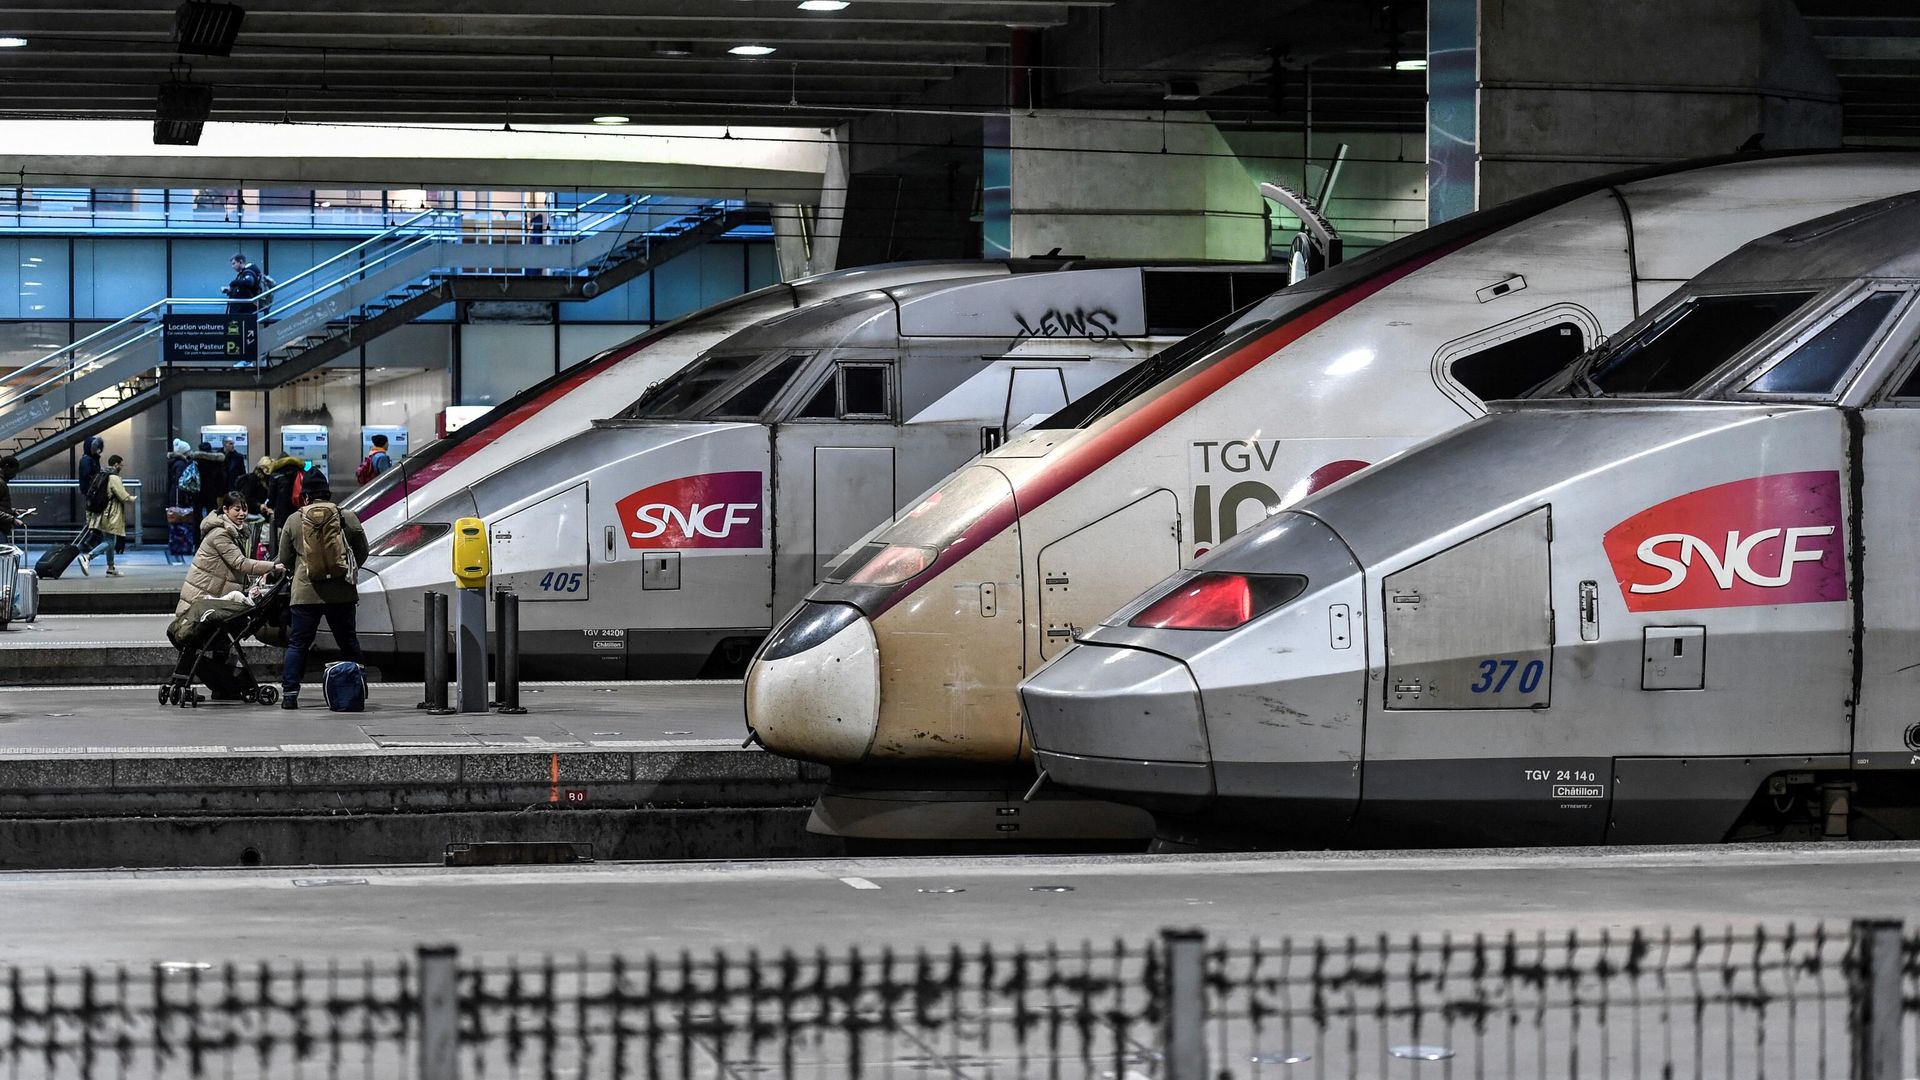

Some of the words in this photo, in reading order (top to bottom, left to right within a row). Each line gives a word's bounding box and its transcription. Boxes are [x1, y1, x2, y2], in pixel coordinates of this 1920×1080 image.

[168, 323, 197, 331] Location
[198, 323, 225, 331] voitures
[174, 342, 199, 351] Parking
[199, 342, 225, 350] Pasteur
[1193, 440, 1281, 473] TGV
[631, 503, 758, 539] SNCF
[1629, 525, 1835, 594] SNCF
[540, 571, 583, 592] 405
[583, 629, 599, 637] TGV
[1471, 659, 1545, 693] 370
[1524, 770, 1551, 781] TGV
[1557, 787, 1599, 796] Châtillon
